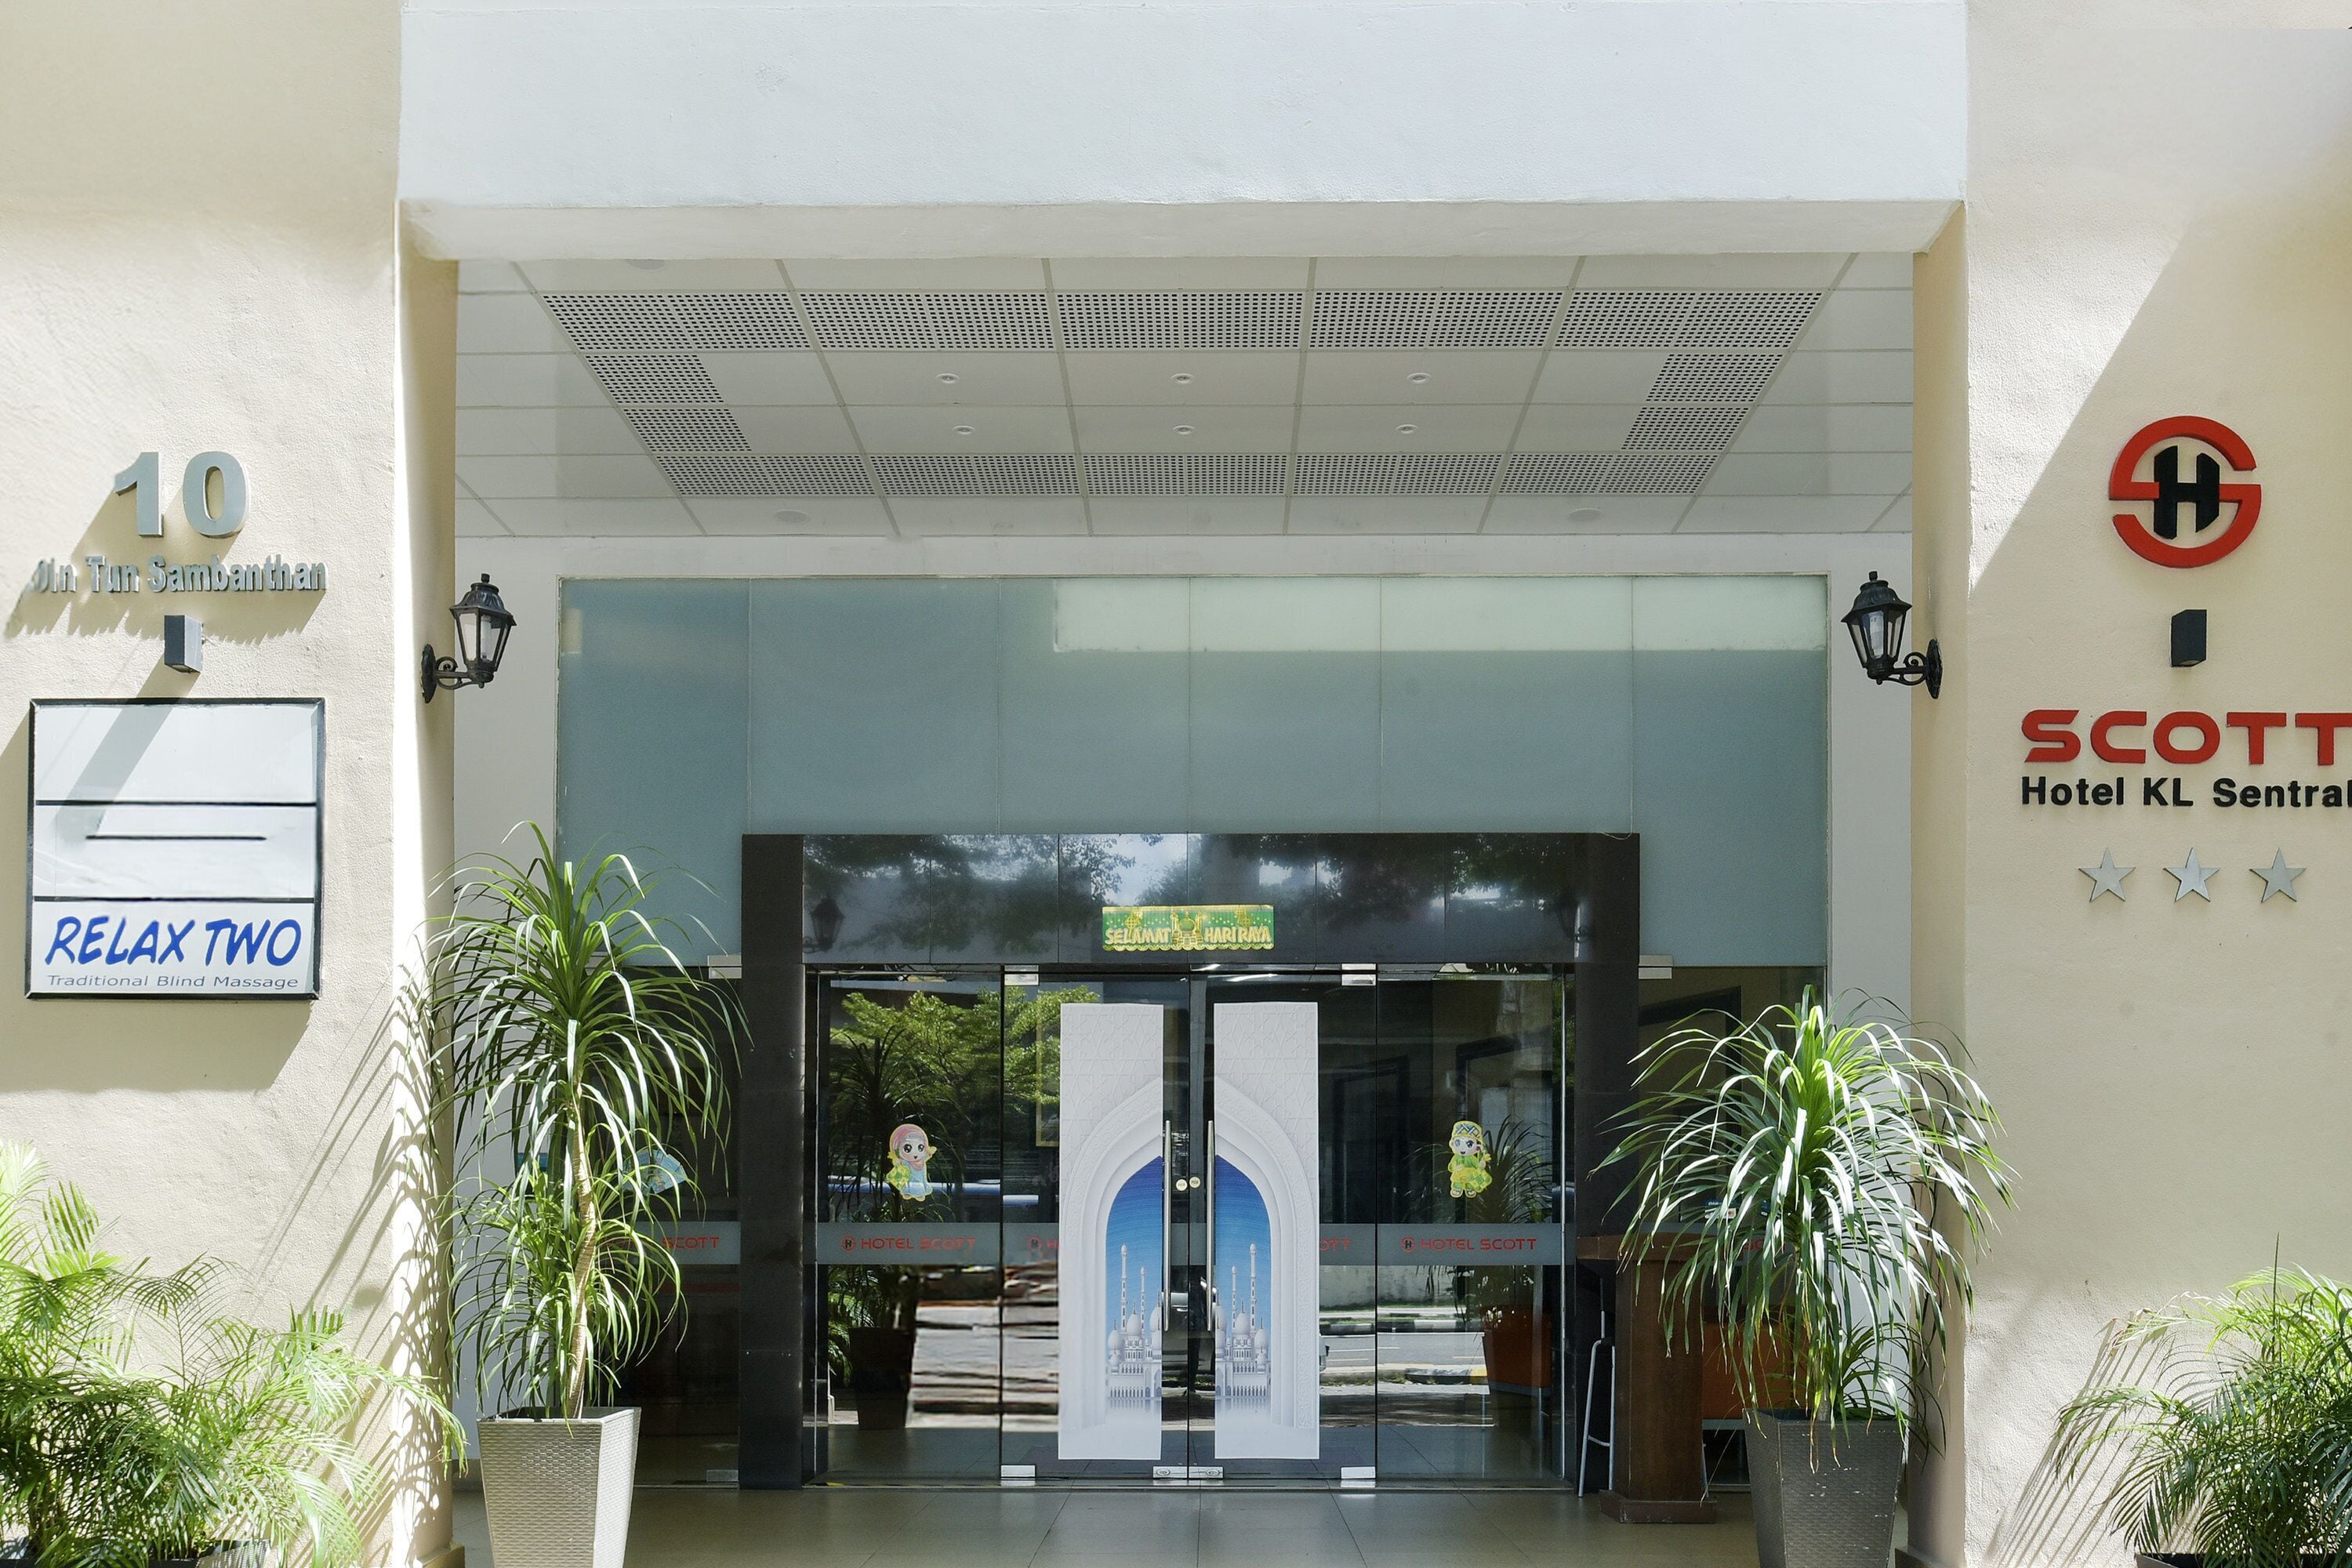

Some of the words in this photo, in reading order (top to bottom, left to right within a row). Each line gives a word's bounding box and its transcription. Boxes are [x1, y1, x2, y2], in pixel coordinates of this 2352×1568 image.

[114, 451, 251, 538] 10
[85, 555, 140, 593] Tun
[147, 554, 328, 593] Sambanthan
[2021, 709, 2352, 766] SCOTT
[2021, 776, 2124, 806] Hotel
[2143, 777, 2194, 807] KL
[45, 916, 195, 966] RELAX
[205, 919, 302, 966] TWO
[1105, 927, 1172, 945] SELAMAT
[1204, 926, 1236, 944] HARI
[1237, 925, 1272, 943] RAYA
[47, 975, 148, 987] Traditional
[157, 975, 205, 987] Blind
[213, 977, 299, 990] Massage
[661, 1237, 720, 1249] SCOTT
[861, 1238, 913, 1250] HOTEL
[920, 1238, 976, 1250] SCOTT
[1420, 1239, 1475, 1250] HOTEL
[1480, 1239, 1537, 1250] SCOTT
